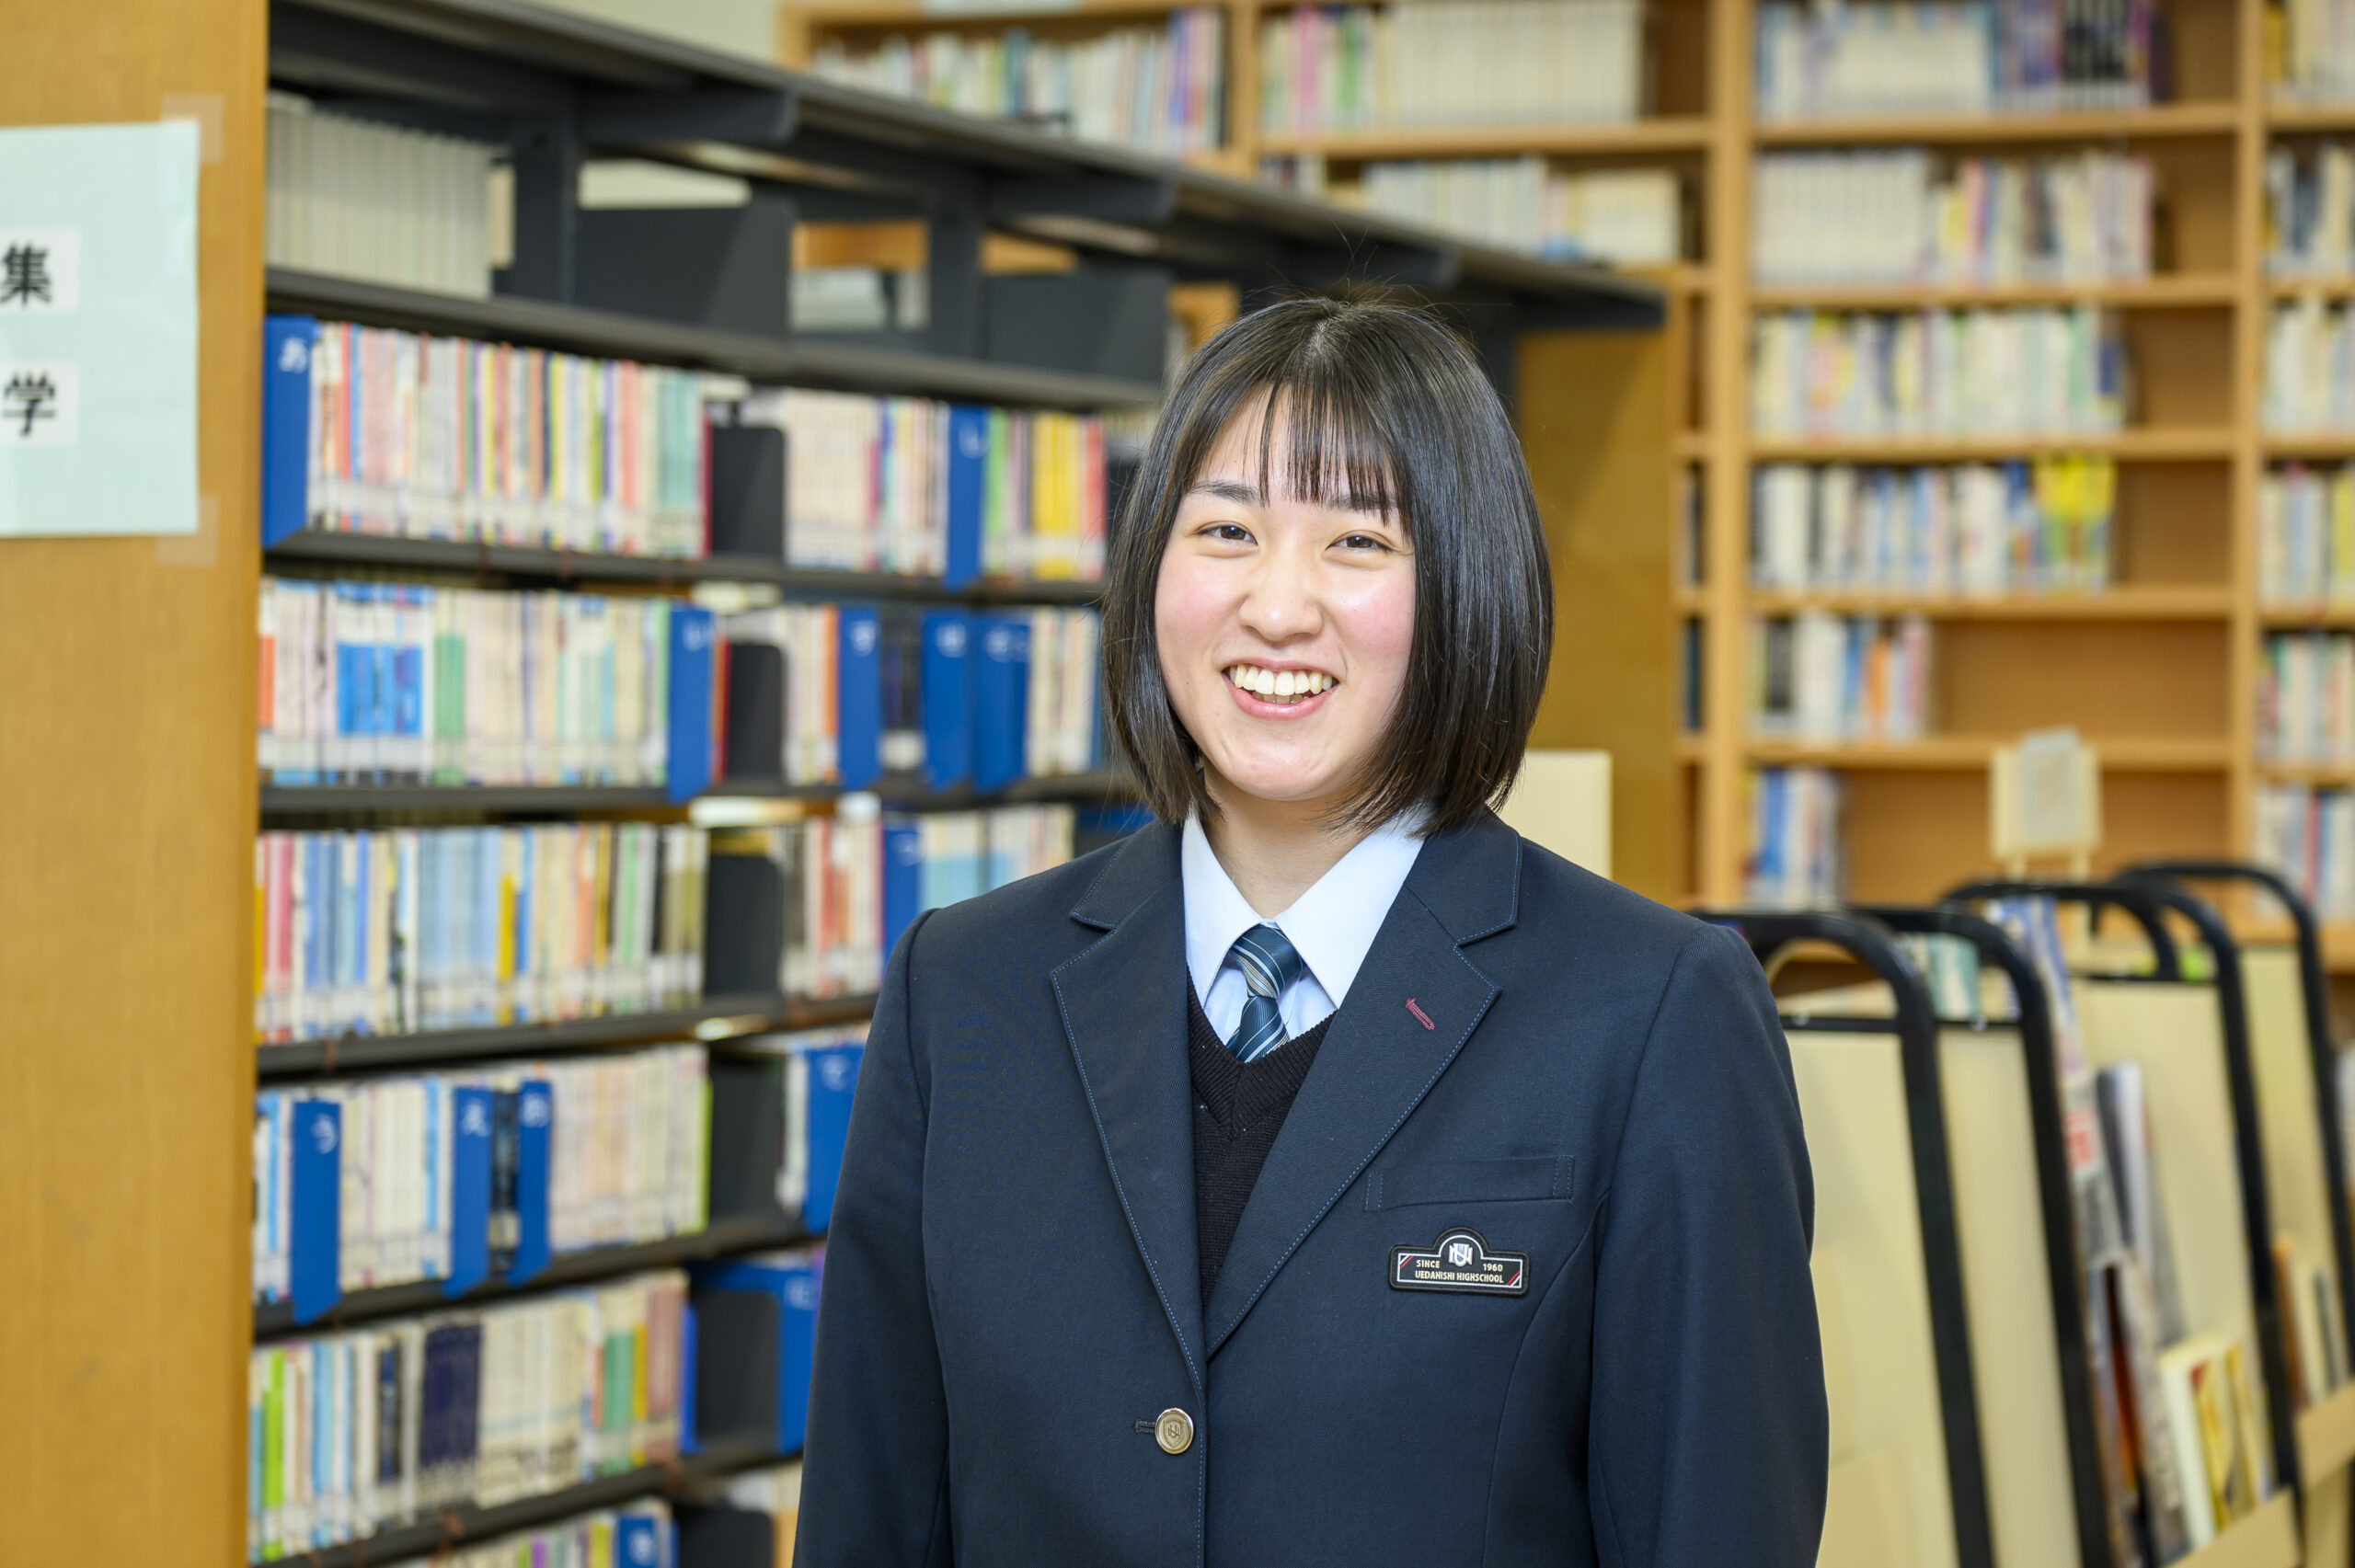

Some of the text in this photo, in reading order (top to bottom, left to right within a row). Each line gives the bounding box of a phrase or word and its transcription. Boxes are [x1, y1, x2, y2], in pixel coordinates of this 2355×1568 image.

[0, 242, 51, 306] 集
[2, 371, 55, 436] 学
[1415, 1270, 1504, 1284] UEDANISHI HIGHSCHOOL
[1416, 1259, 1503, 1272] SINCE 1960
